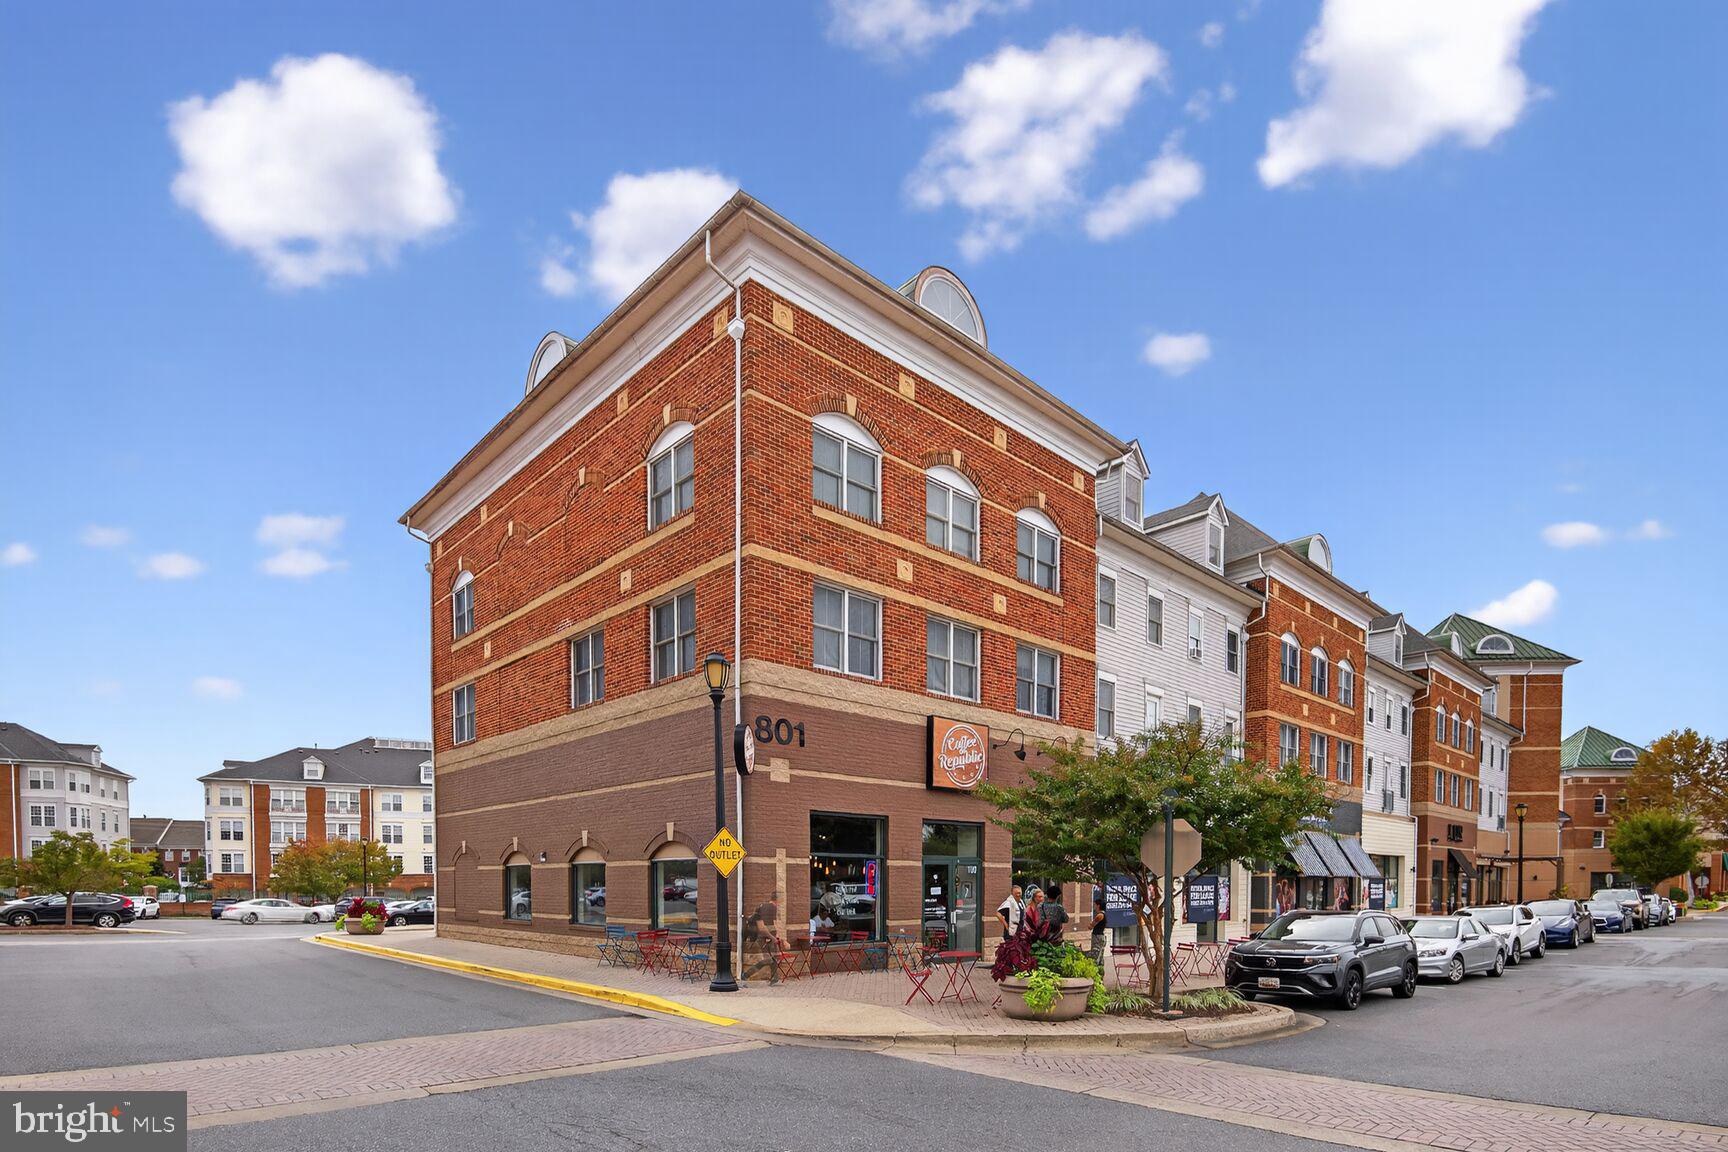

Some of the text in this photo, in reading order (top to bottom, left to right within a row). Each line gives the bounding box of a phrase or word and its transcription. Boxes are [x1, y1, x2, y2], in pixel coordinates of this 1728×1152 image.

[755, 715, 805, 748] 801
[947, 735, 977, 755] Coffee
[938, 749, 983, 770] Republic
[719, 838, 732, 847] NO
[709, 850, 741, 860] OUTLET
